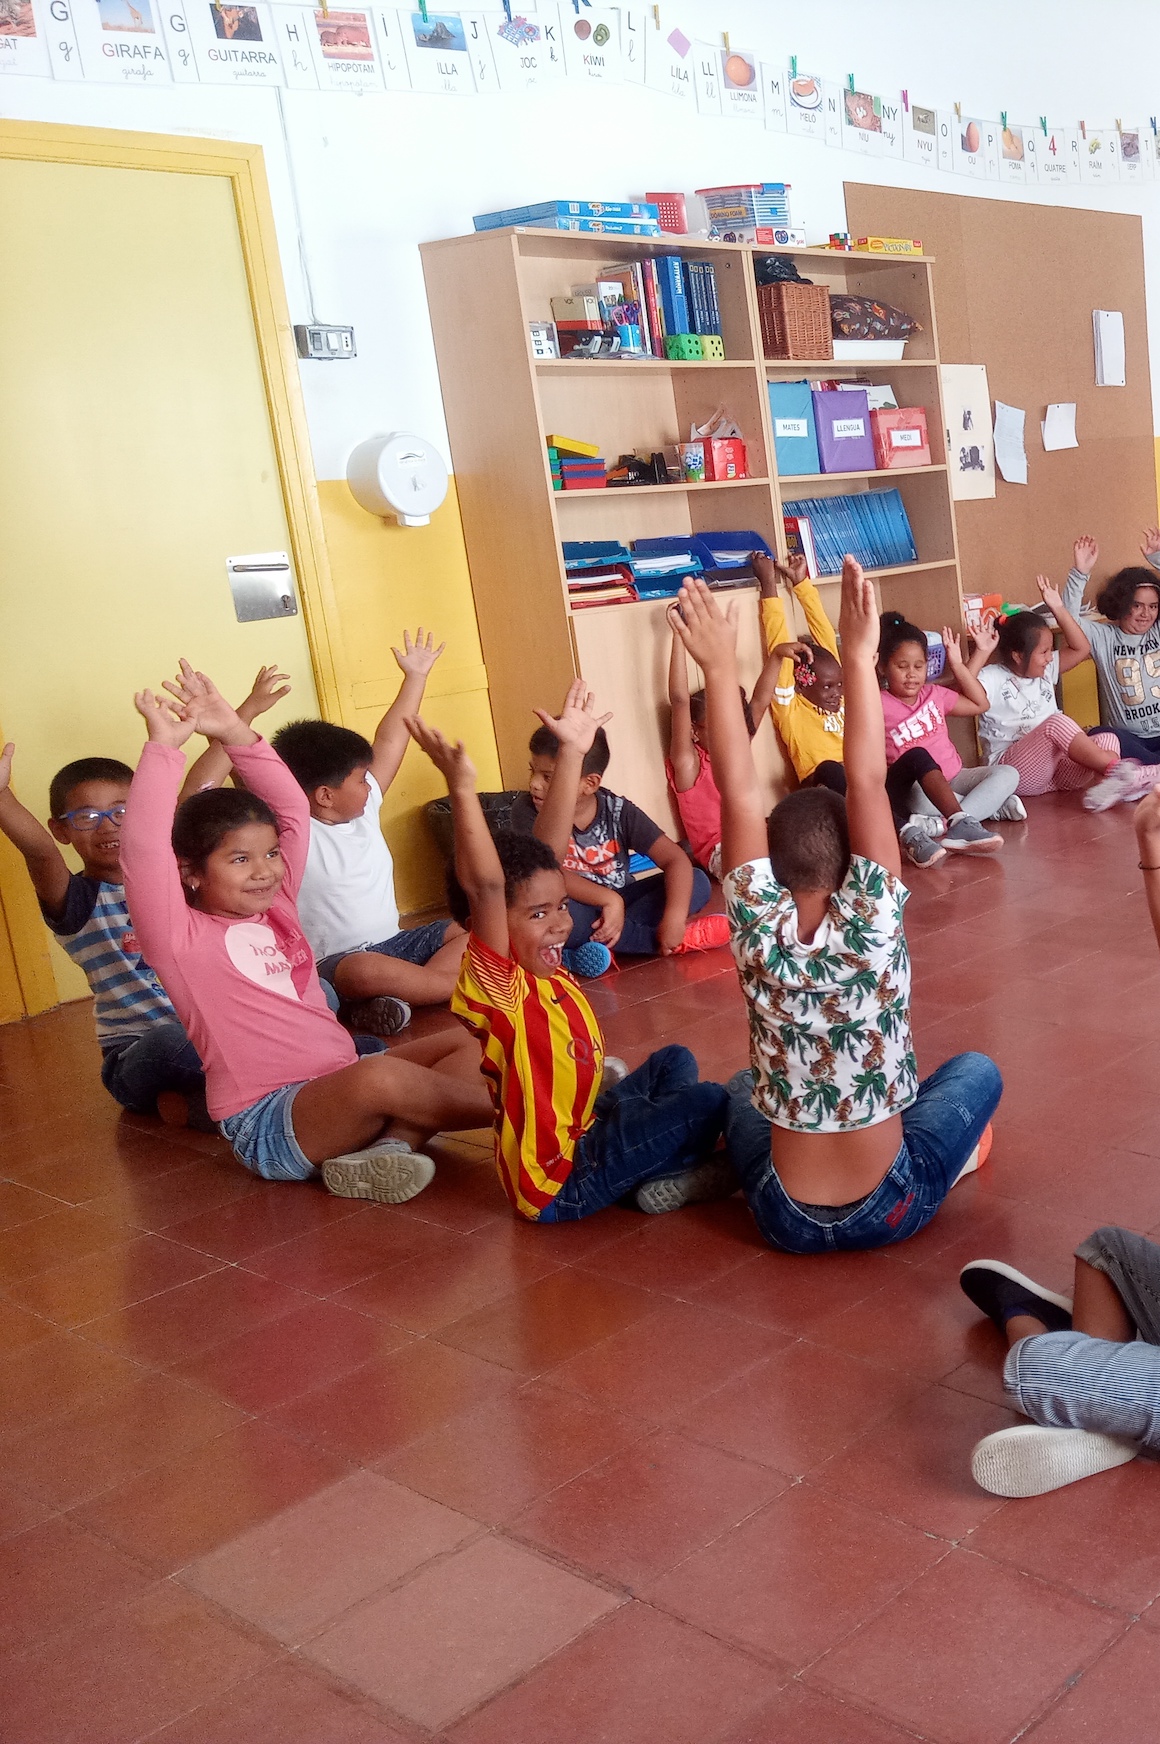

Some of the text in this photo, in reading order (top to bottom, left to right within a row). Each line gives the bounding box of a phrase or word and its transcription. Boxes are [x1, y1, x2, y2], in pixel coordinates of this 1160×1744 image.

[50, 0, 69, 22] G
[169, 14, 186, 33] G
[627, 11, 636, 32] L
[286, 24, 300, 42] H
[470, 21, 478, 39] J
[545, 25, 555, 42] K
[58, 41, 73, 62] g
[102, 42, 165, 61] GIRAFA
[178, 49, 190, 66] g
[208, 48, 277, 65] GUITARRA
[292, 50, 308, 71] h
[520, 56, 537, 69] JOC
[122, 64, 154, 81] girafa
[702, 61, 715, 77] LL
[771, 80, 780, 95] M
[828, 98, 836, 112] N
[882, 105, 898, 121] NY
[859, 131, 869, 143] NIU
[988, 134, 994, 147] P
[917, 139, 933, 151] NYU
[1028, 140, 1035, 153] Q
[1048, 134, 1057, 156] 4
[1071, 140, 1078, 152] R
[1109, 141, 1115, 153] S
[968, 155, 976, 165] OU
[1008, 161, 1021, 171] POMA
[1044, 163, 1066, 174] QUATRE
[782, 423, 801, 432] MATES
[836, 423, 861, 433] LLENGUA
[899, 434, 913, 442] MEDI
[1113, 645, 1136, 657] NEW
[889, 700, 944, 749] HEY!
